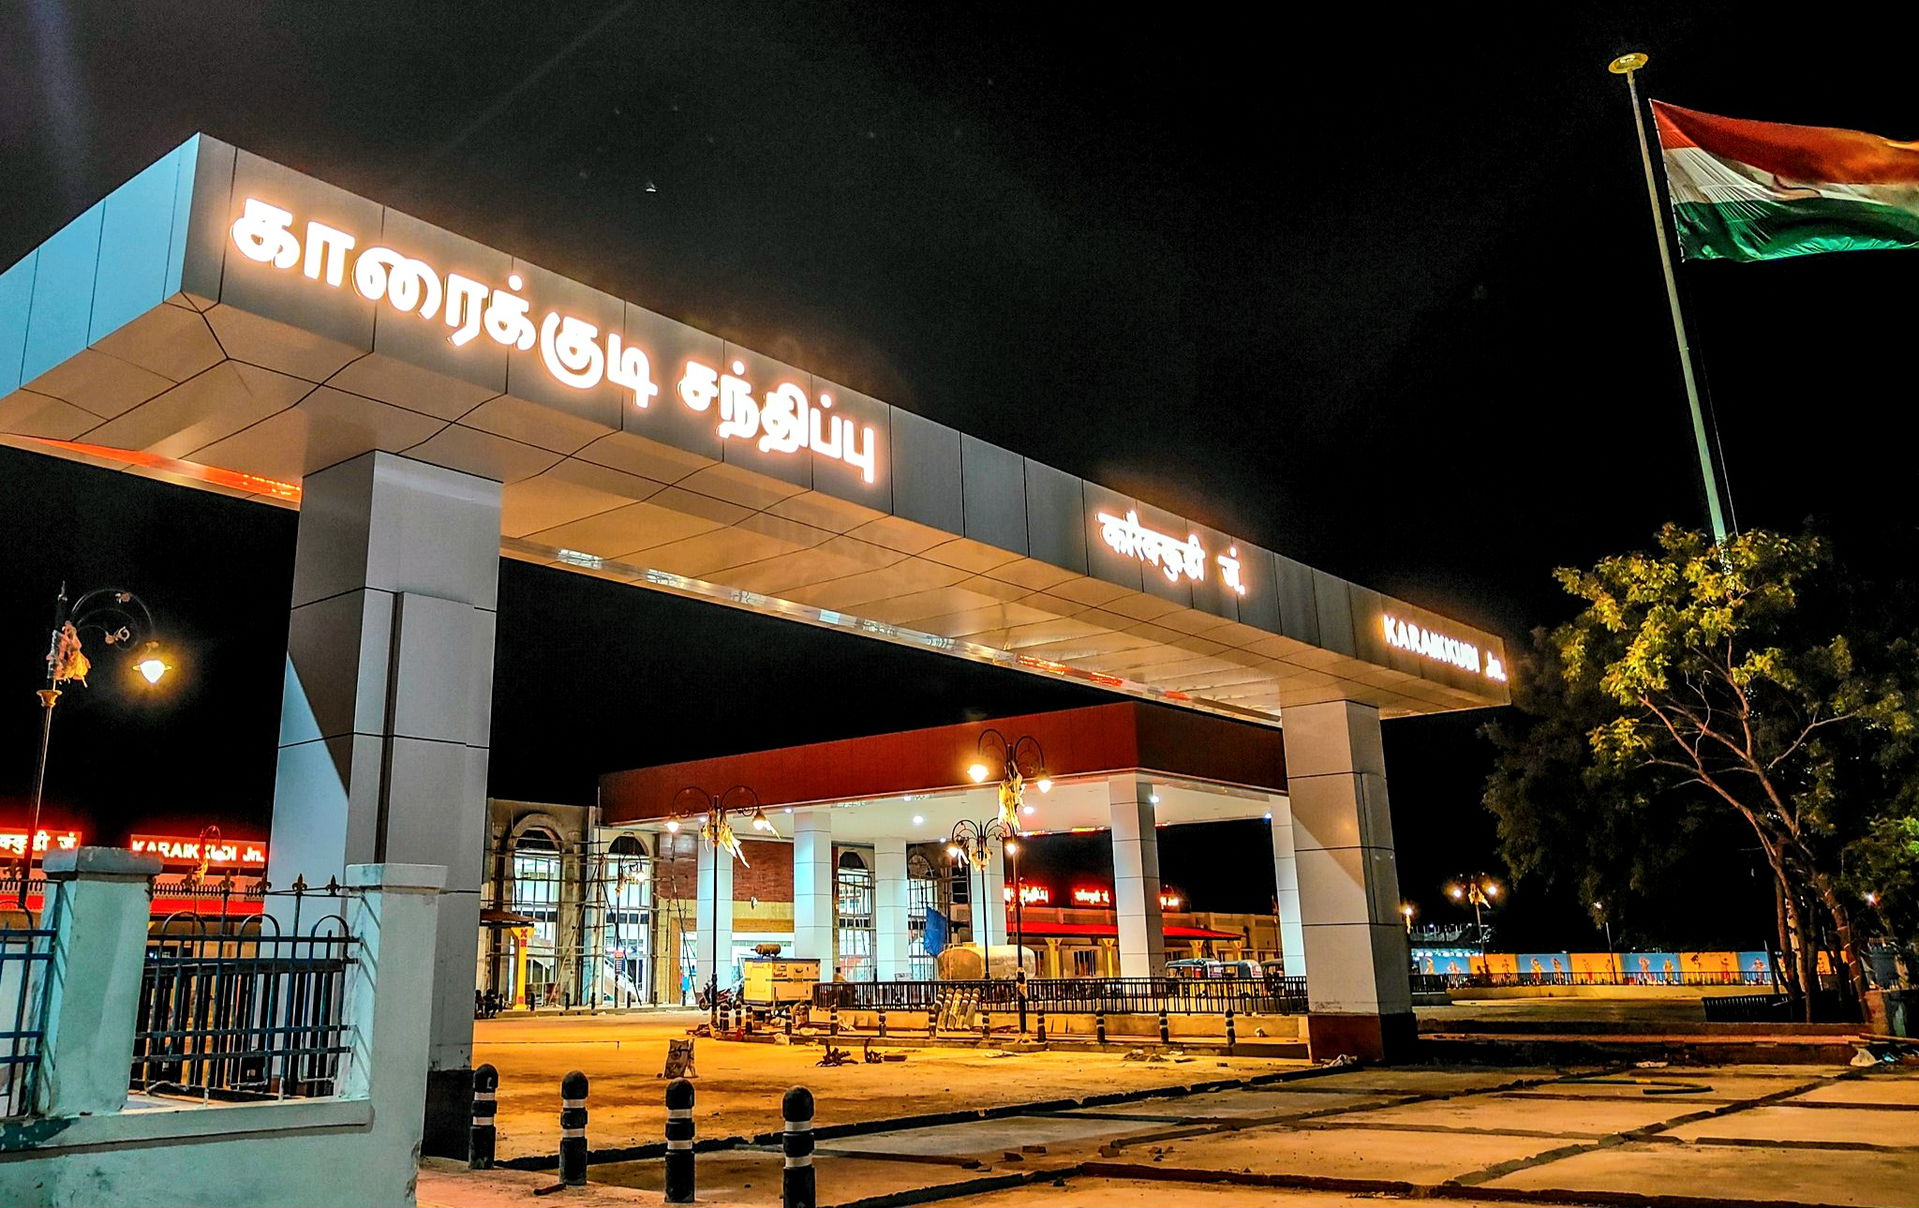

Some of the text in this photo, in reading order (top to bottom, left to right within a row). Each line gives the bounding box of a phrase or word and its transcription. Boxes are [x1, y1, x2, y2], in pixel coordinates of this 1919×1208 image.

[231, 198, 874, 483] காரைக்குடி சந்திப்பு
[1383, 614, 1480, 673] KARAIKKUDI
